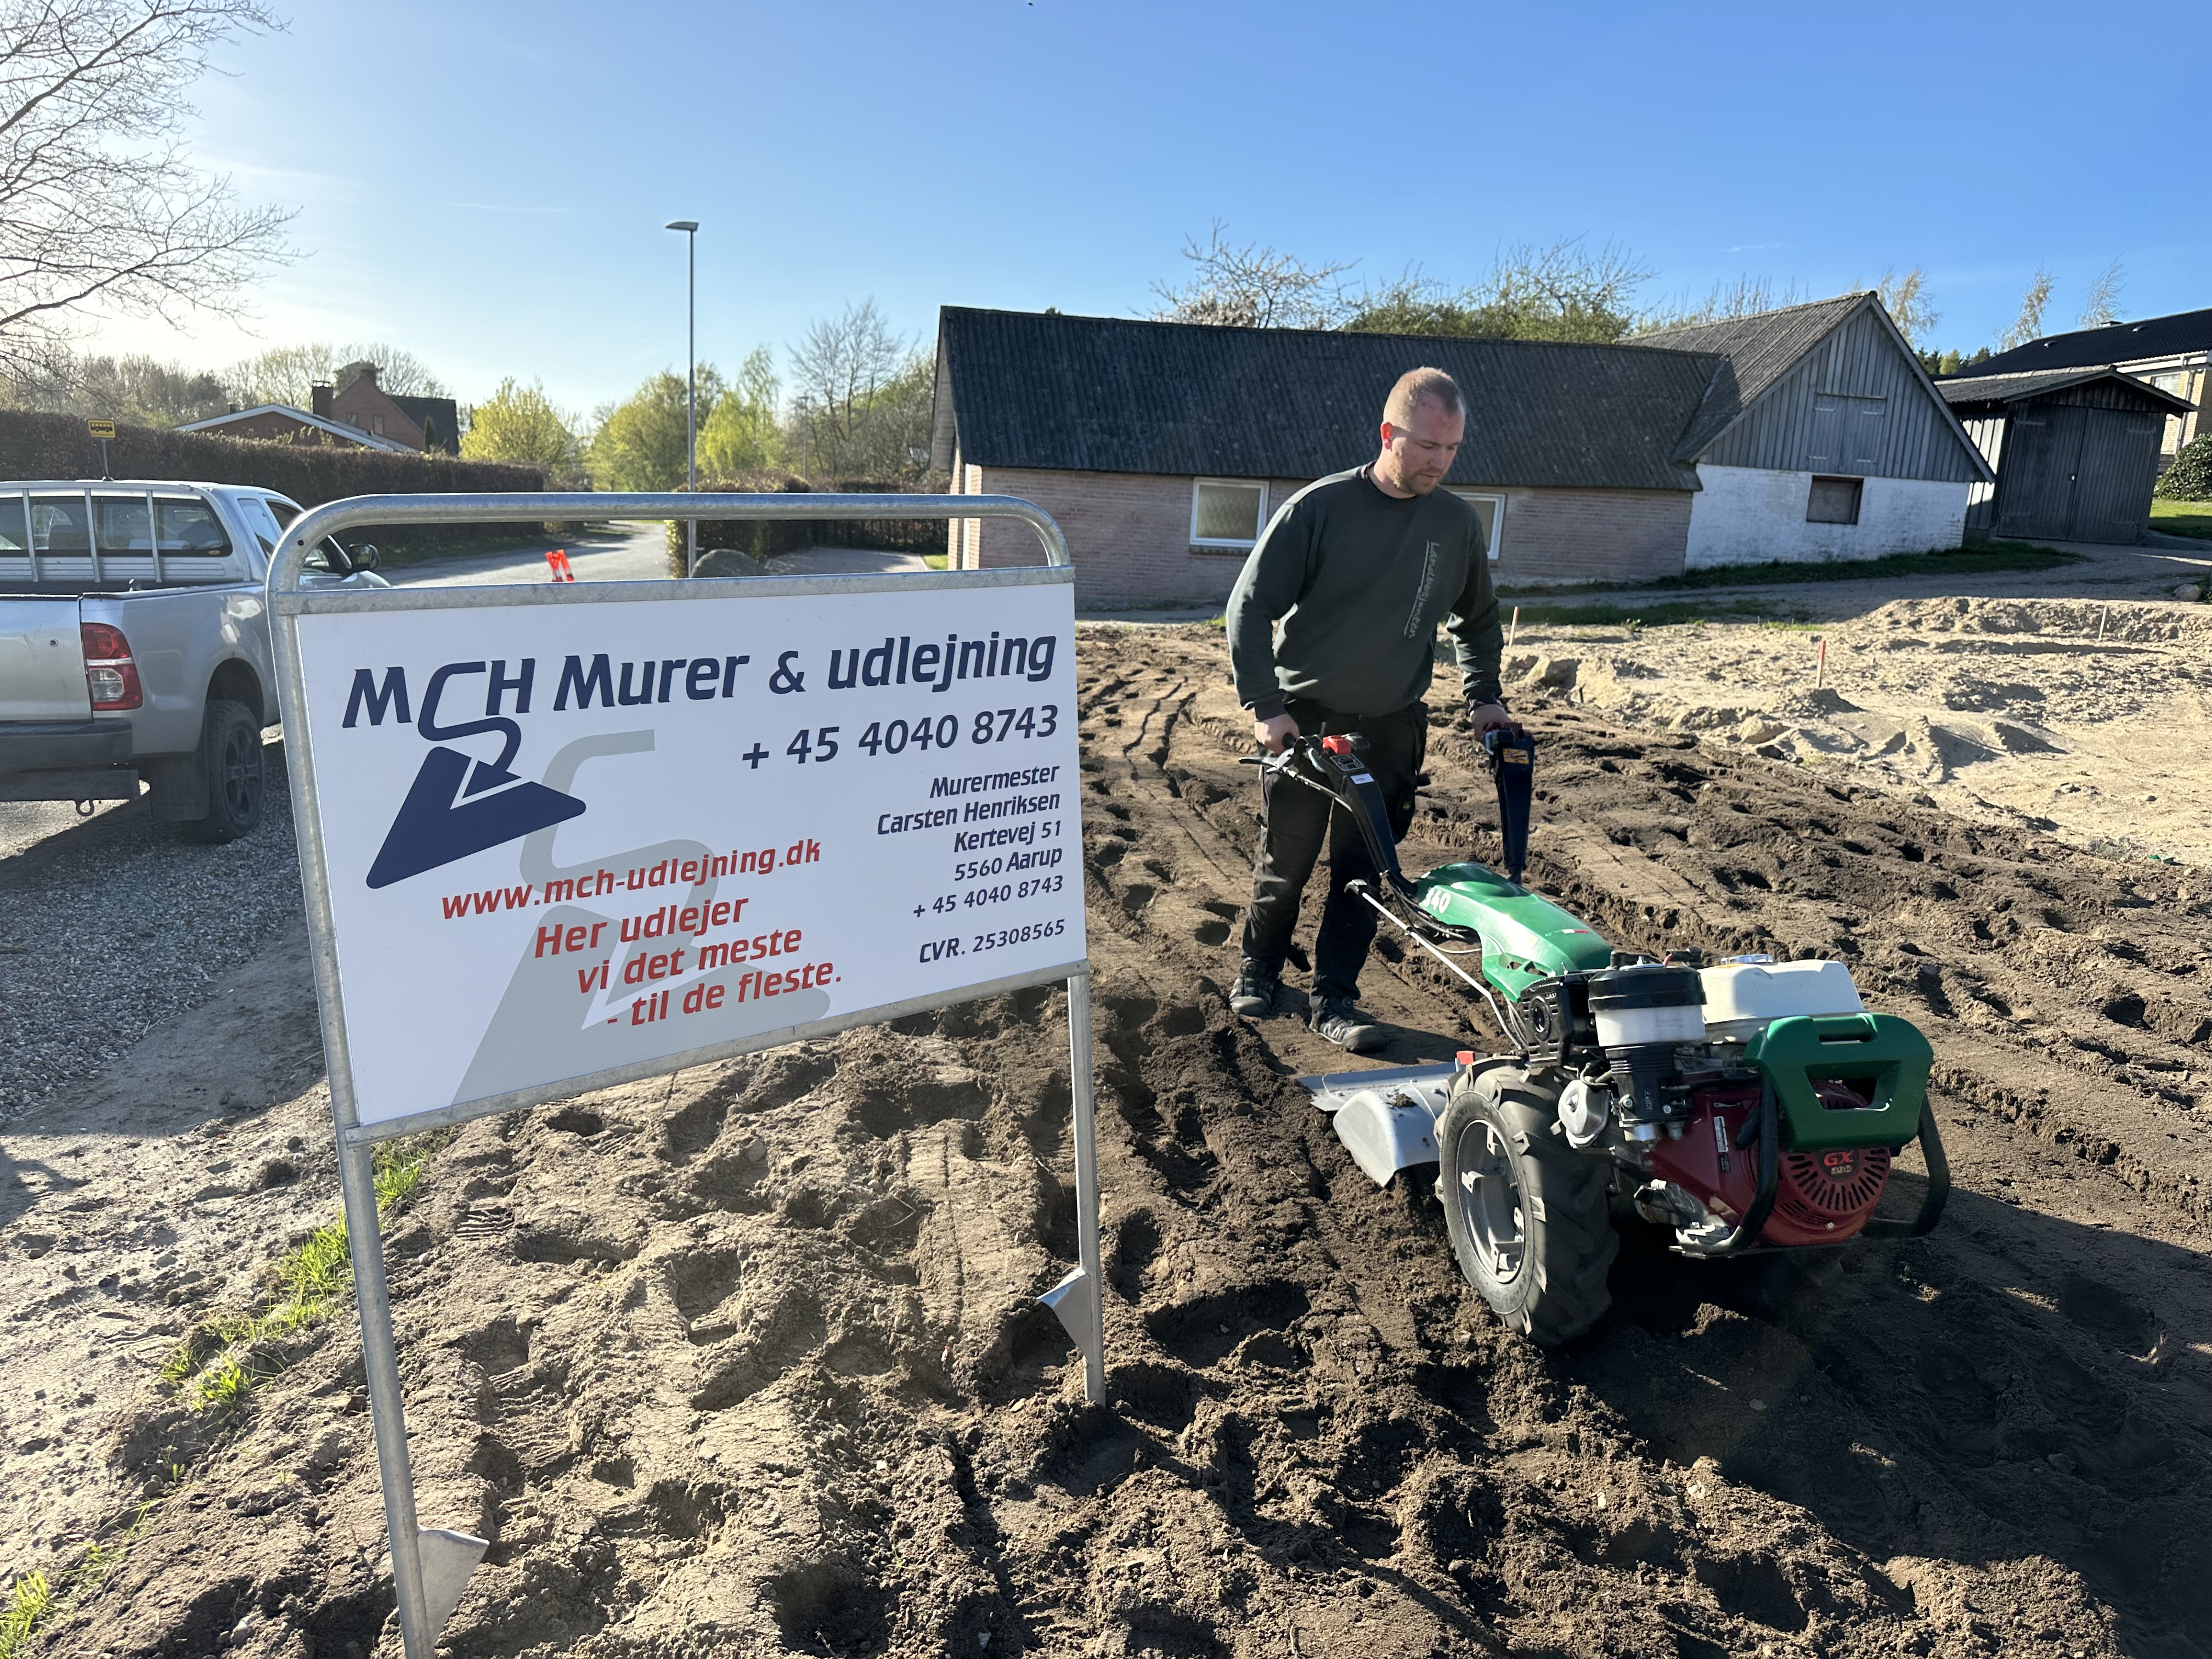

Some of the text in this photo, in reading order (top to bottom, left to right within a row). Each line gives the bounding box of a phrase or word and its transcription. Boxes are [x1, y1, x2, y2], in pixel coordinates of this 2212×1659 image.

[342, 631, 1057, 738] MCH Murer & udlejning
[742, 704, 1058, 769] + 45 4040 8743
[929, 765, 1060, 799] Murermester
[877, 793, 1060, 835] Carsten Henriksen
[953, 820, 1061, 853] Kertevej 51
[442, 838, 821, 920] www.mch-udlejning.dk
[954, 848, 1063, 881] 5560 Aarup
[913, 875, 1063, 918] + 45 4040 8743
[534, 898, 749, 958] Her udlejer
[919, 918, 1065, 963] CVR. 25308565
[578, 929, 802, 994] vi det meste
[631, 990, 669, 1026] til
[682, 983, 725, 1014] de
[737, 962, 842, 1003] fleste.
[1824, 1150, 1853, 1166] GX
